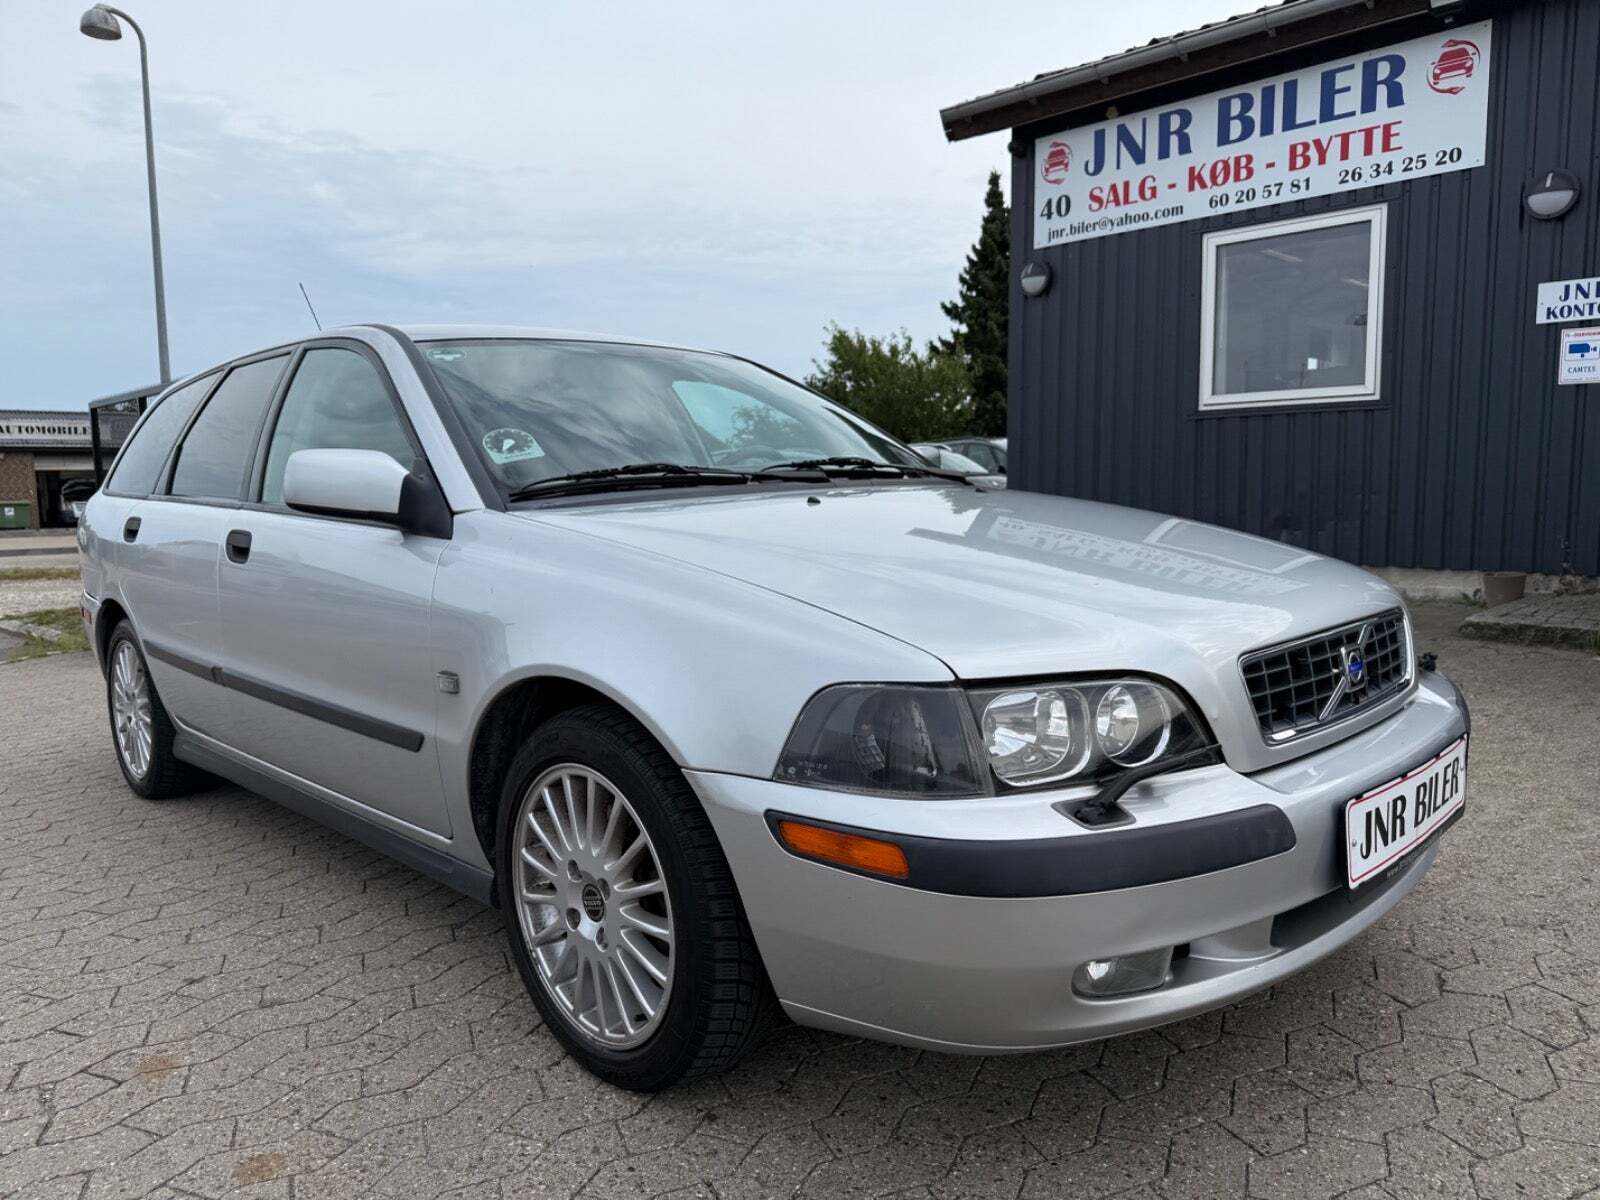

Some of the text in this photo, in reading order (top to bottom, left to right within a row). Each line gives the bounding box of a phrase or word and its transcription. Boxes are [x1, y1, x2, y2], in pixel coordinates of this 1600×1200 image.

[1084, 53, 1407, 177] JNR BILER
[1088, 175, 1157, 213] SALG
[1188, 153, 1254, 193] KØB
[1265, 161, 1276, 169] -
[1288, 120, 1403, 172] BYTTE
[1209, 147, 1462, 209] 60 20 57 81 26 34 25 20
[1040, 194, 1071, 220] 40
[1048, 205, 1184, 243] jnr.biler@yahoo.com
[1360, 795, 1407, 859] JNR
[1414, 757, 1460, 828] BILER
